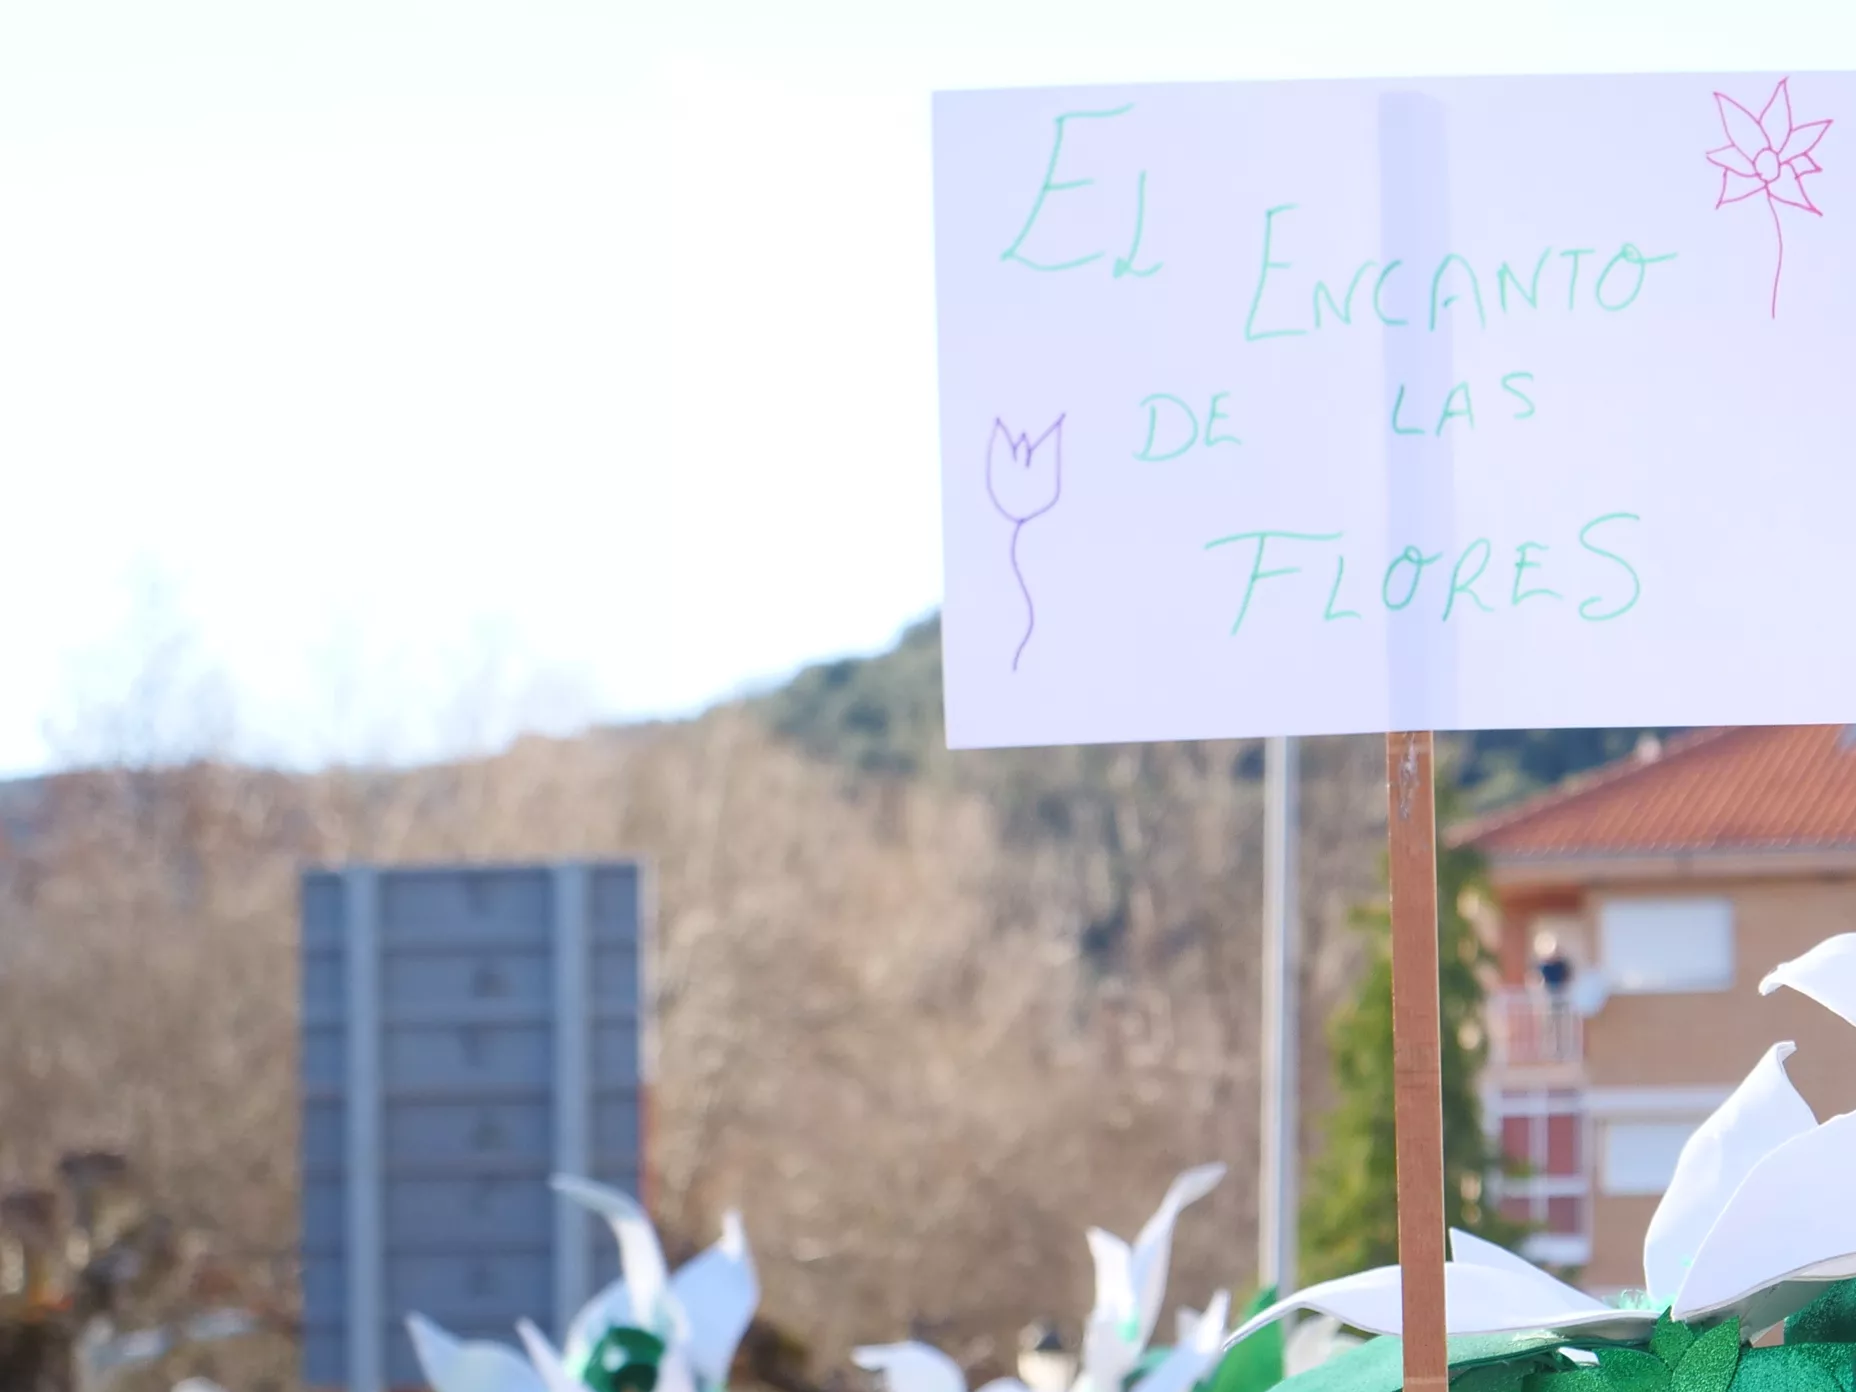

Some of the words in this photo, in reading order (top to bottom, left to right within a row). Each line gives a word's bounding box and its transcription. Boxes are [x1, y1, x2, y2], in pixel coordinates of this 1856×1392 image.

[1241, 202, 1679, 344] ENCANTO
[1131, 389, 1244, 464] DE
[1388, 369, 1537, 438] LAS
[1201, 510, 1643, 638] FLORES
